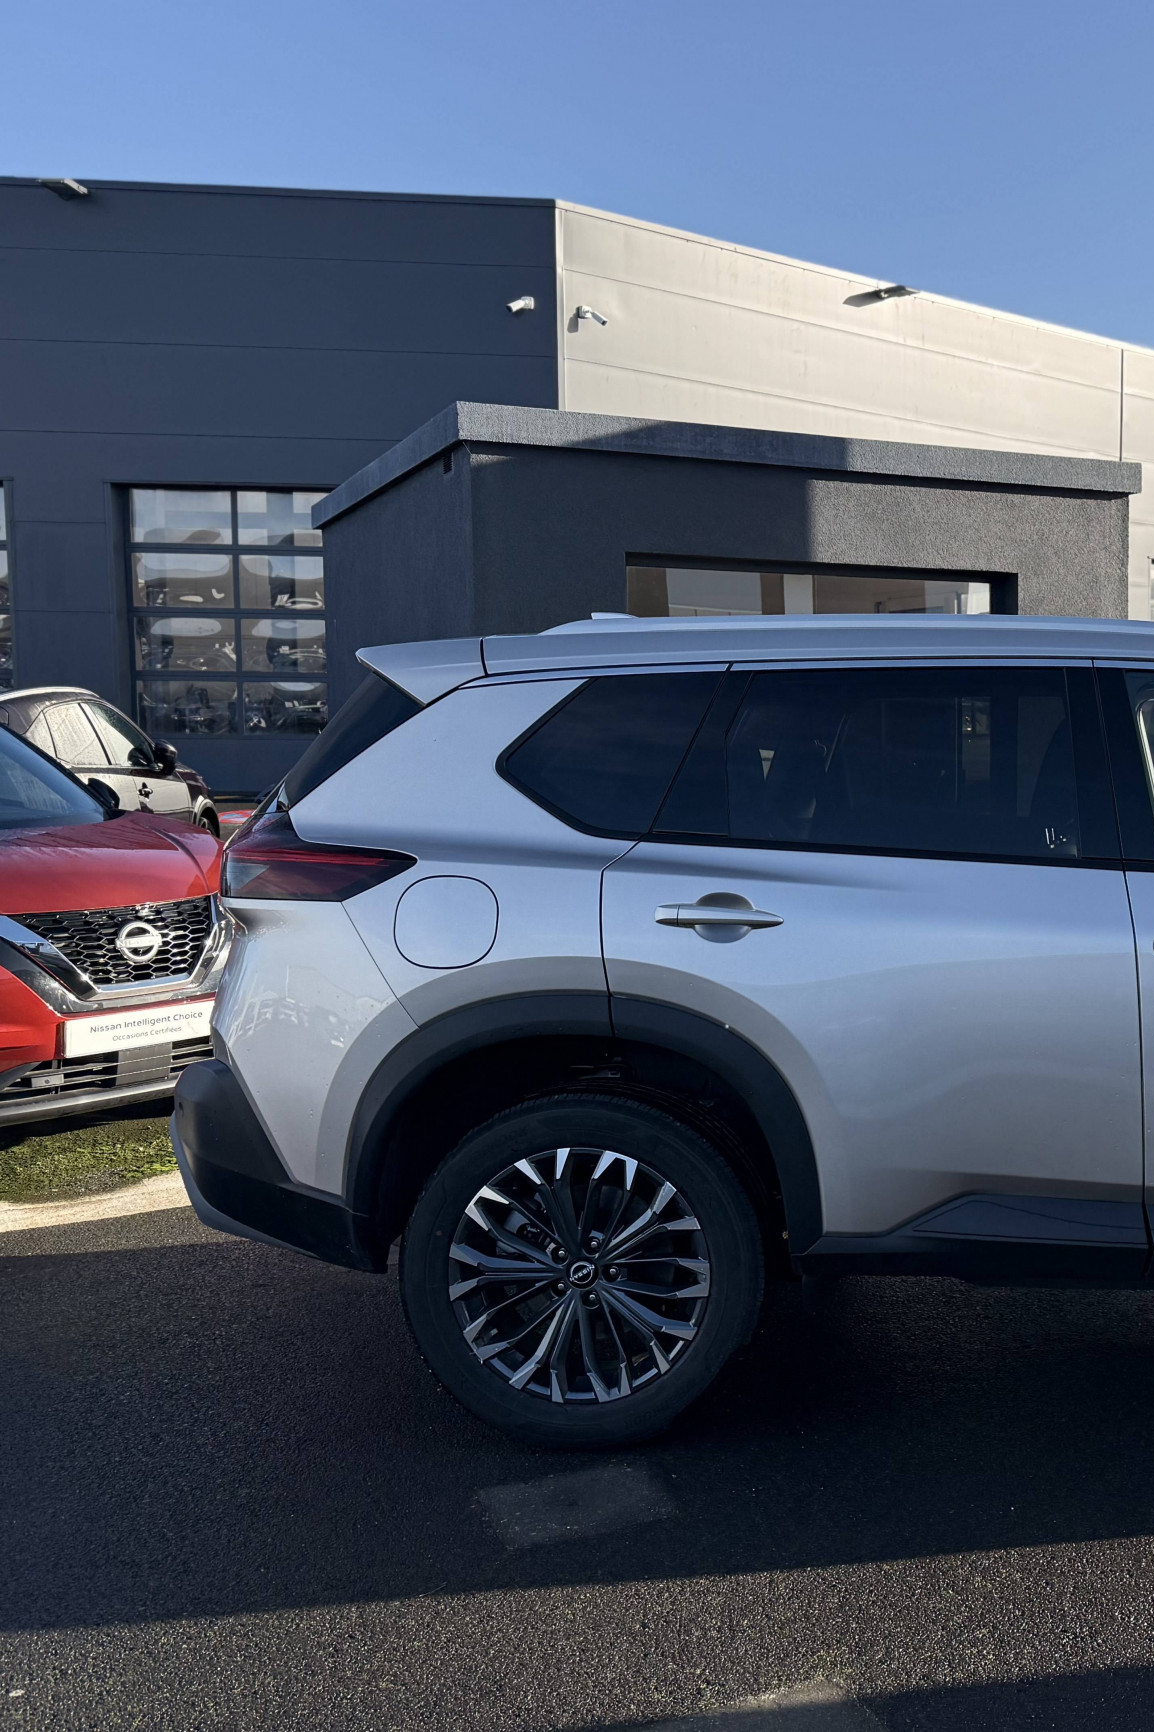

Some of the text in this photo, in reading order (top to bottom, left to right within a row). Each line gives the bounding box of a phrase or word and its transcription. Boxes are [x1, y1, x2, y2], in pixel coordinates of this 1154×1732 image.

[90, 1010, 203, 1034] Nissan Intelligent Choice
[112, 1026, 182, 1042] Occasions Certifiées
[570, 1264, 595, 1282] NISSAN
